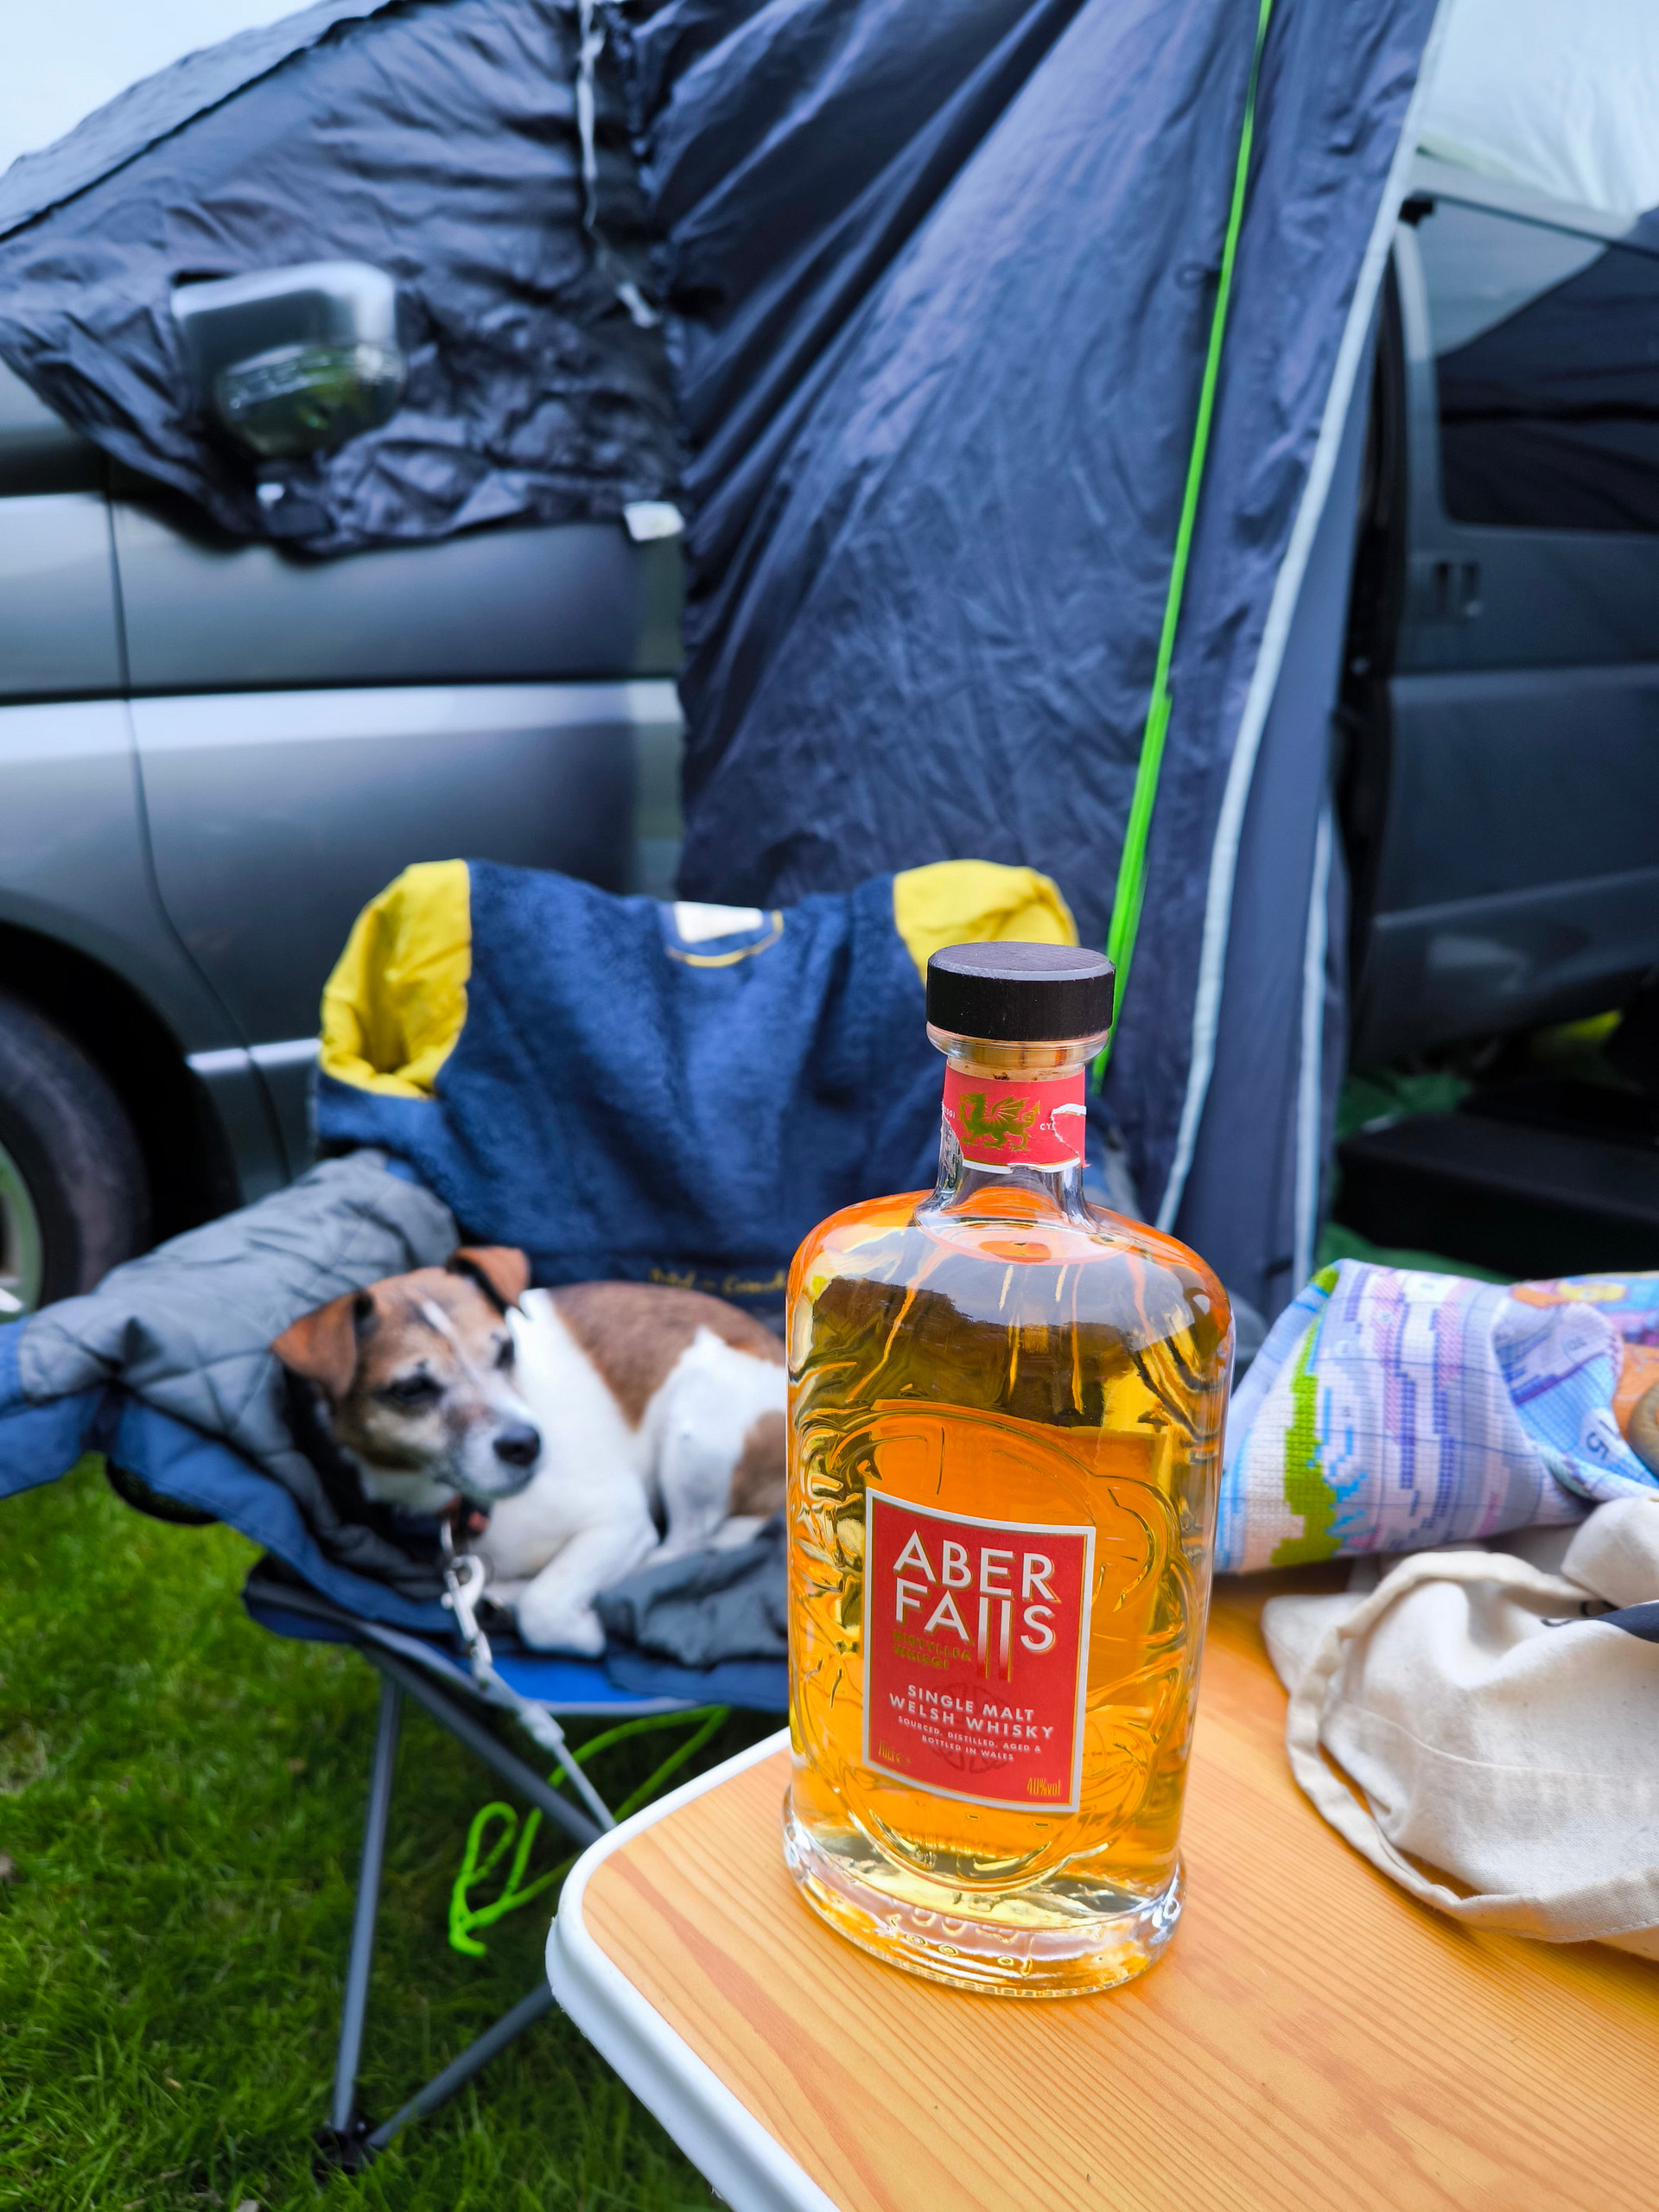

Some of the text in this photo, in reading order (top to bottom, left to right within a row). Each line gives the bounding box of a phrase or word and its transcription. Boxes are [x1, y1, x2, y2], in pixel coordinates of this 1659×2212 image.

[893, 1529, 1060, 1601] ABER
[889, 1694, 1053, 1739] WELSH WHISKY
[908, 1685, 1034, 1721] SINGLE MALT
[922, 1735, 1014, 1761] BOTTLED IN WALES
[1003, 1742, 1030, 1752] AGED
[1034, 1745, 1041, 1753] &
